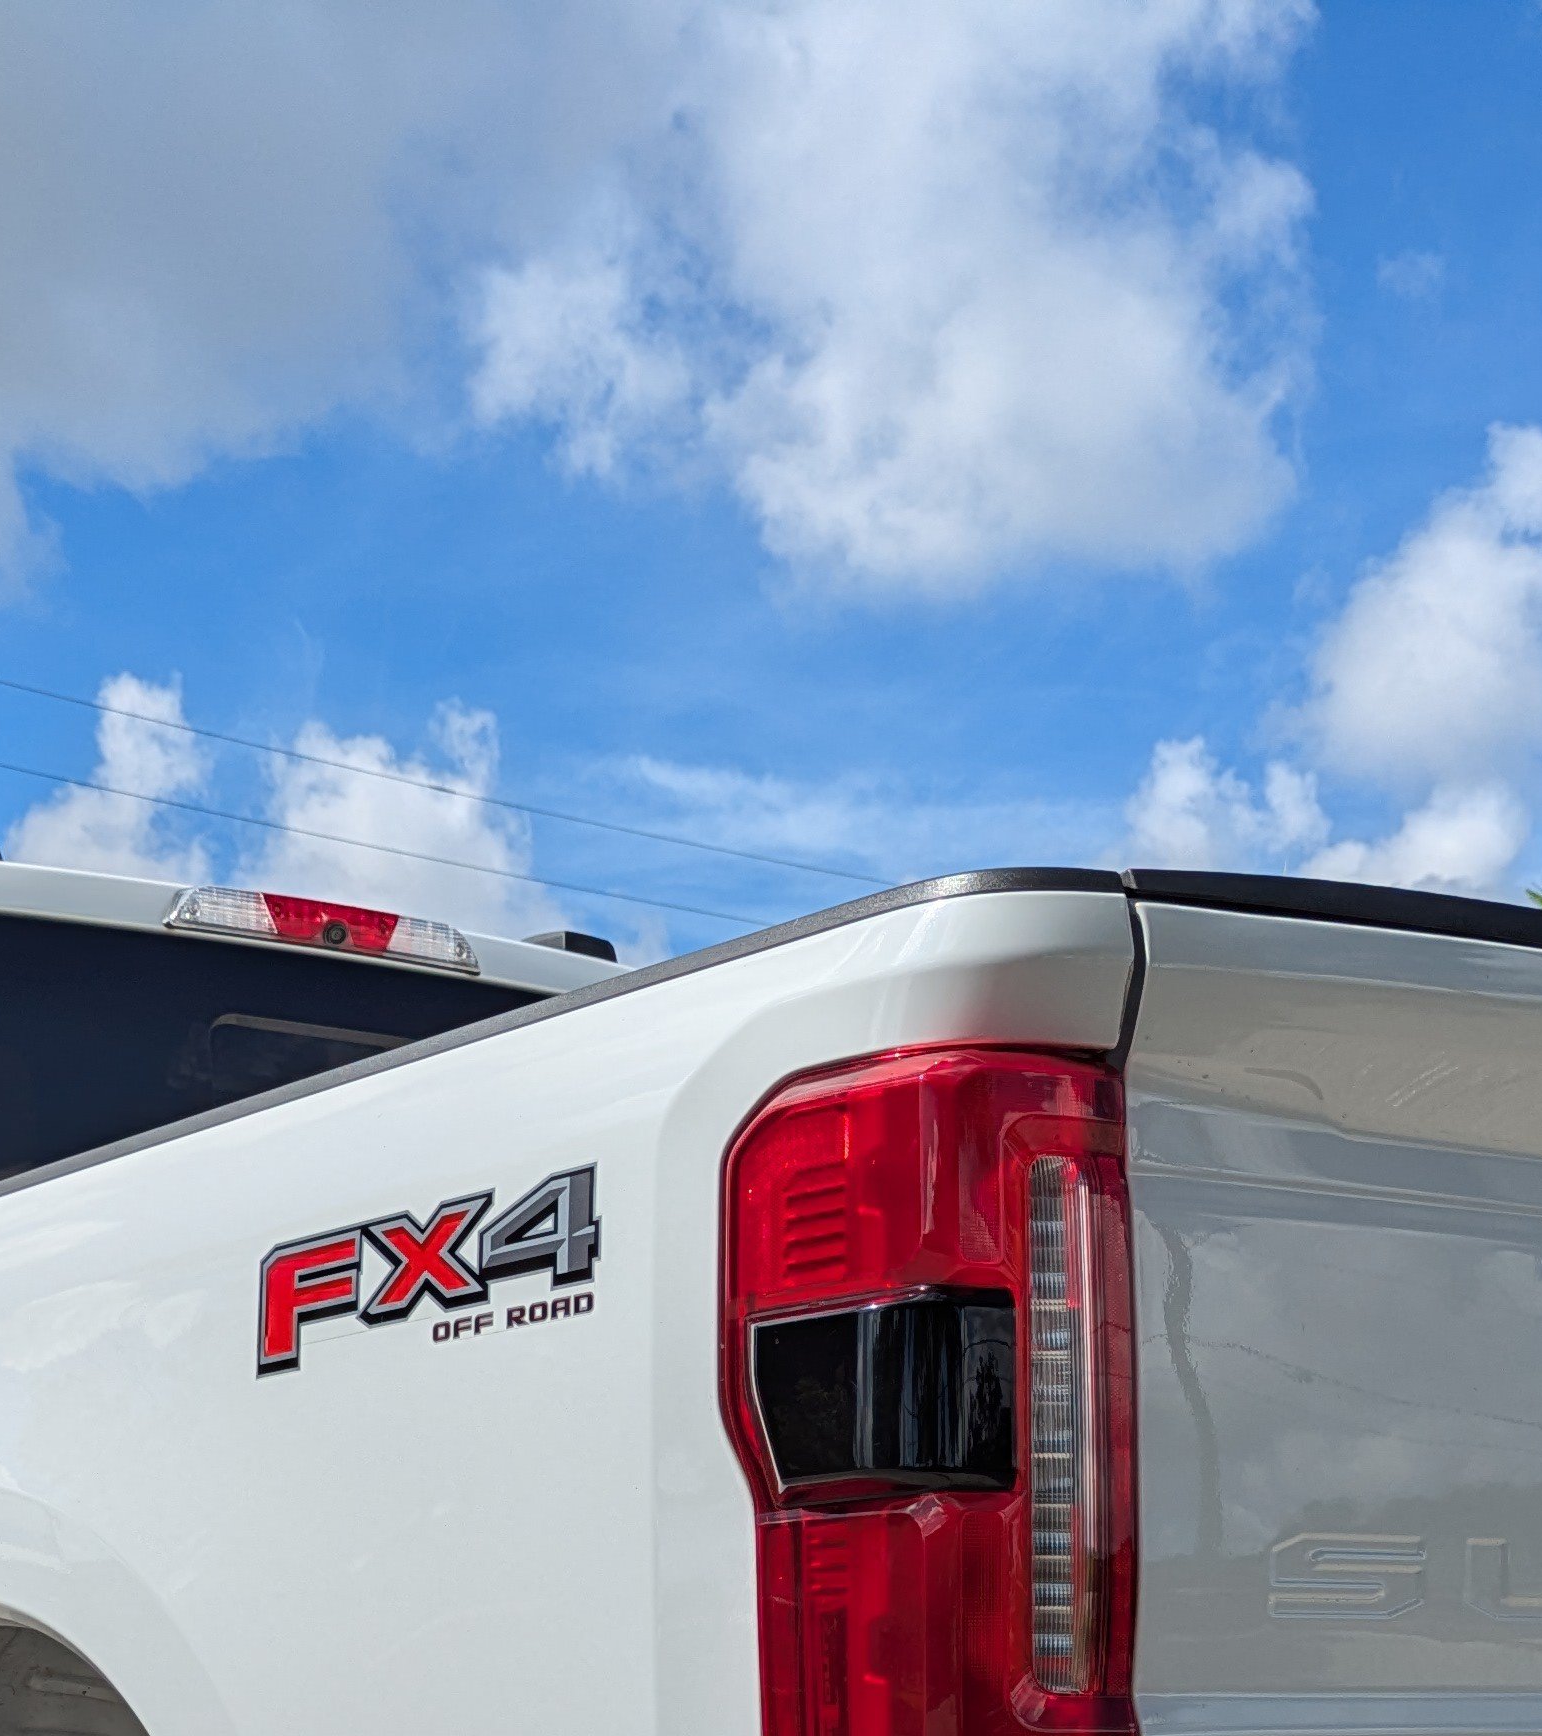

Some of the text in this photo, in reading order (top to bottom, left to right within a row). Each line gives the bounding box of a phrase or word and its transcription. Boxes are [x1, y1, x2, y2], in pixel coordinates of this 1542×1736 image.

[256, 1161, 601, 1380] FX4
[433, 1291, 594, 1343] OFF ROAD
